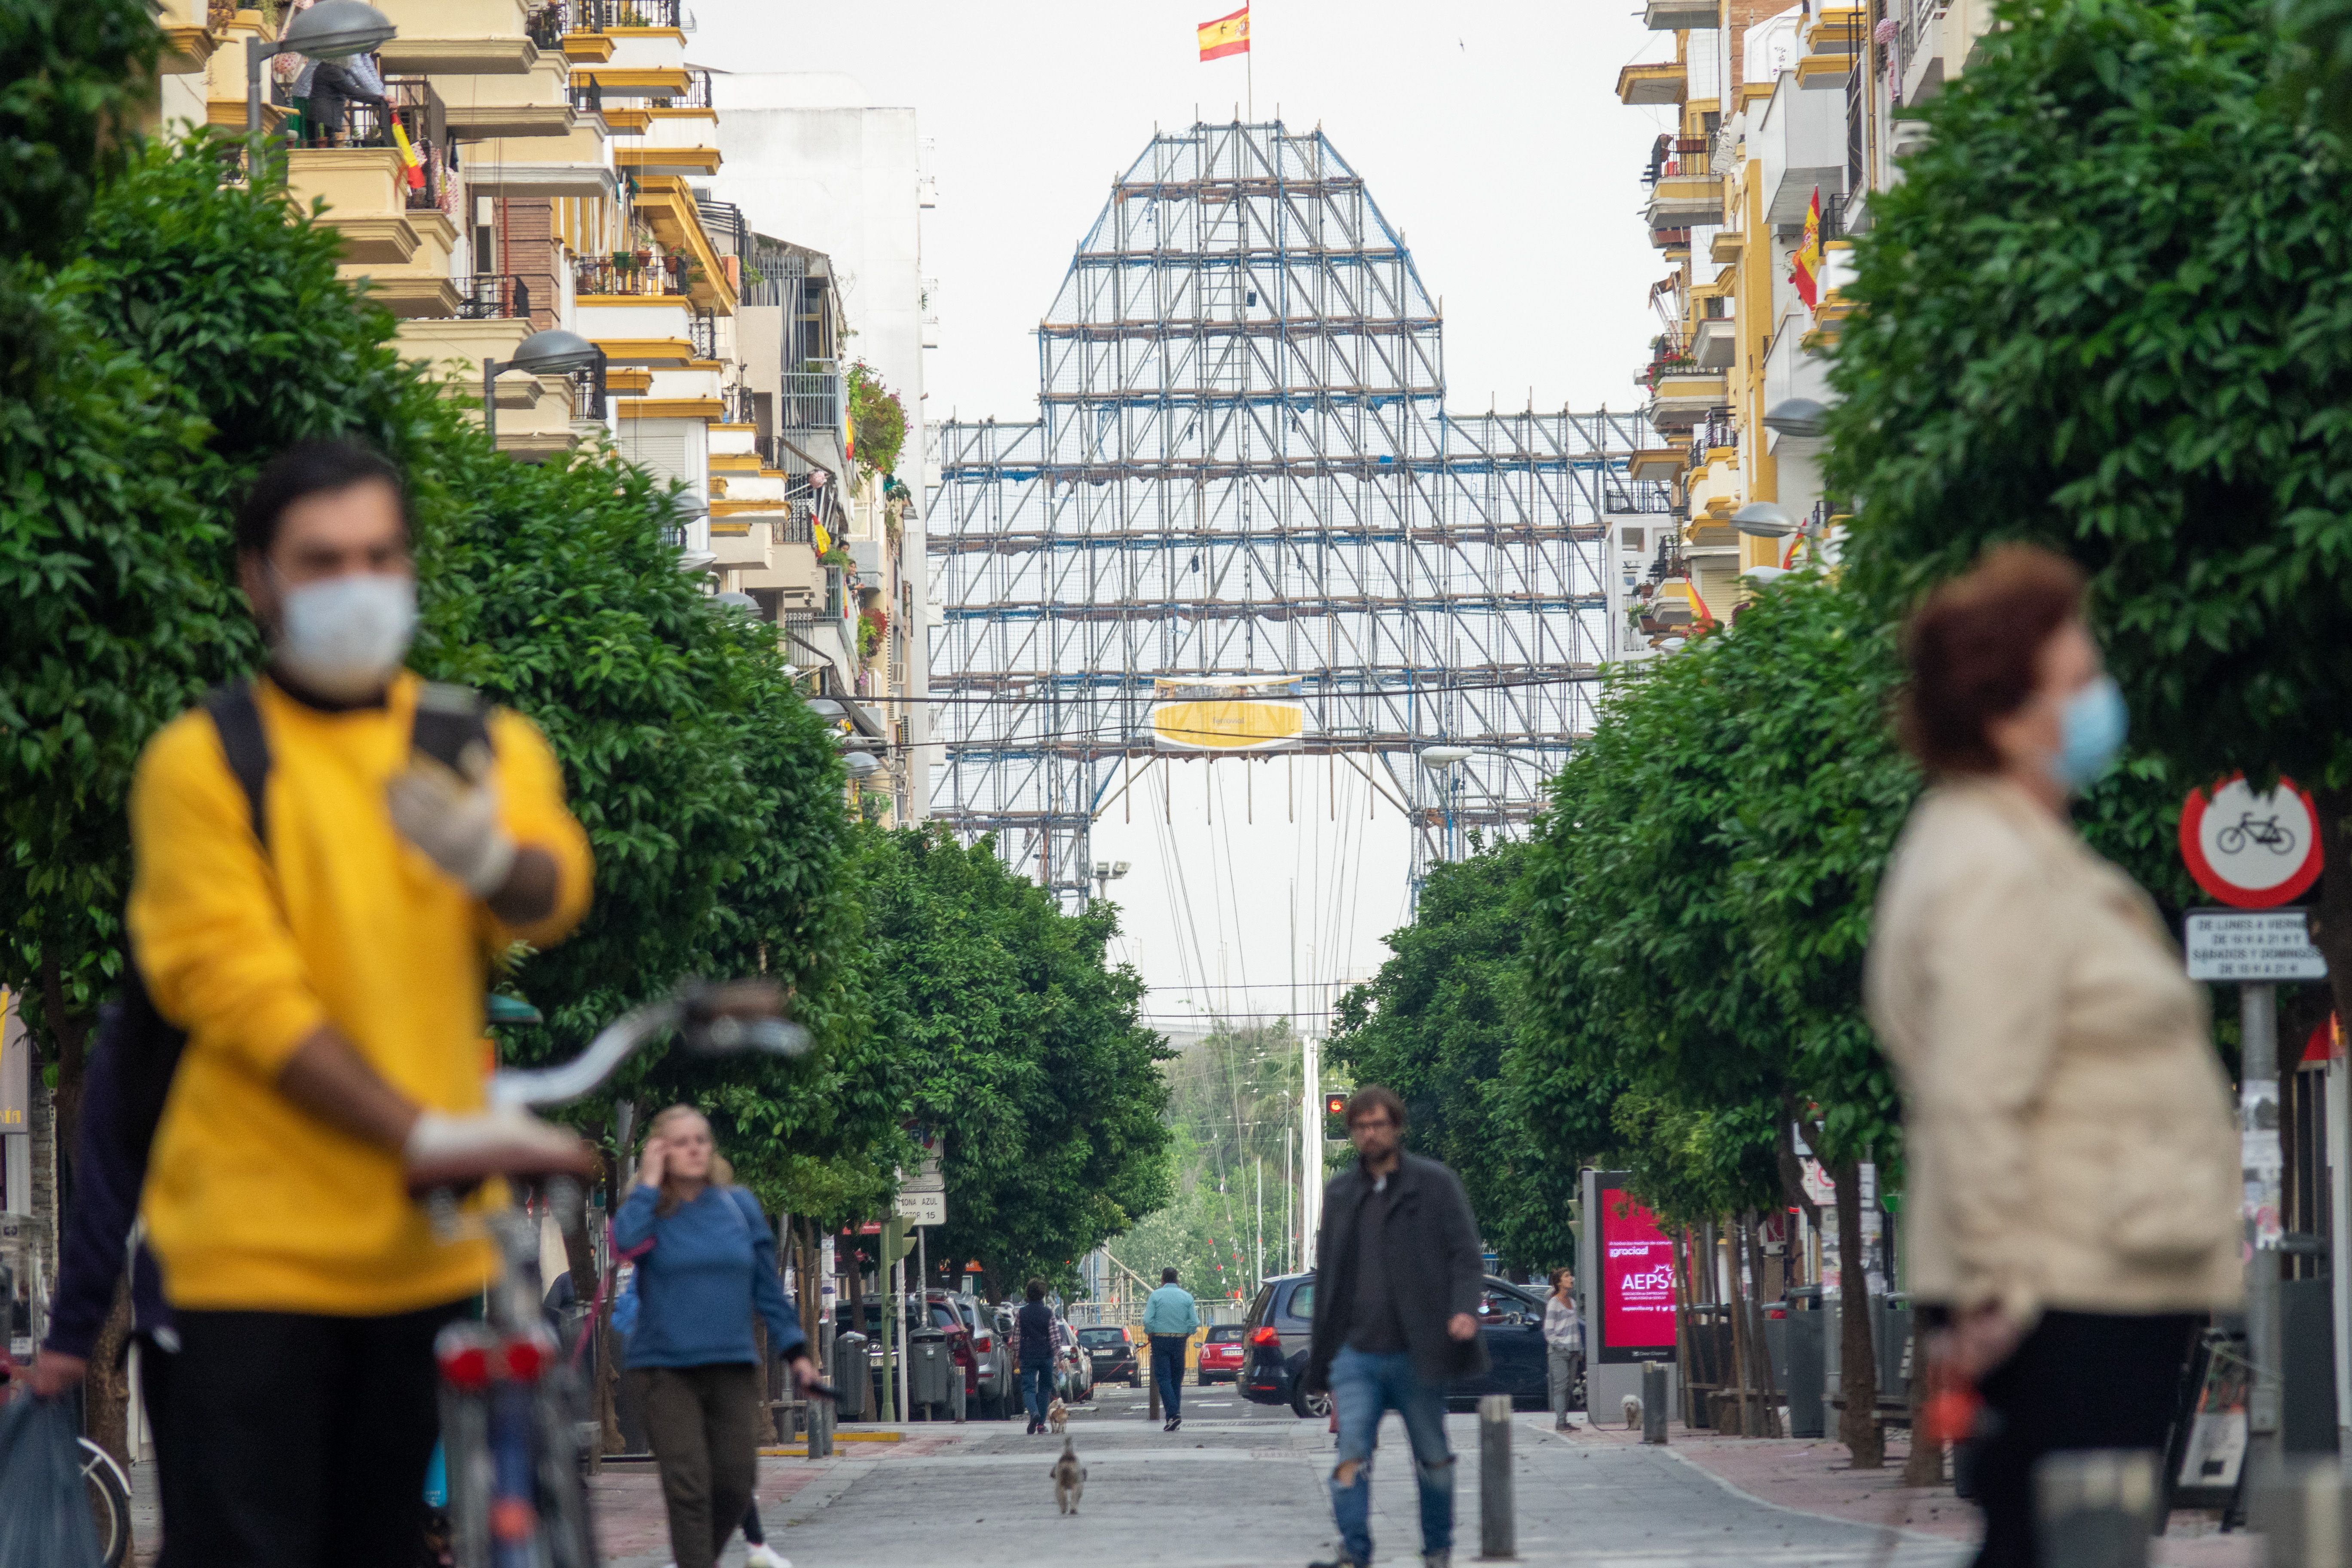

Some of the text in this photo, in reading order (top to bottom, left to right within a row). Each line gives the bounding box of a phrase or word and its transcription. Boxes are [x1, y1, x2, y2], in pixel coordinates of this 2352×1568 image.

[2199, 919, 2212, 931] DE
[2213, 934, 2226, 944] DE
[2219, 963, 2233, 974] DE
[1621, 1274, 1669, 1289] AEPS
